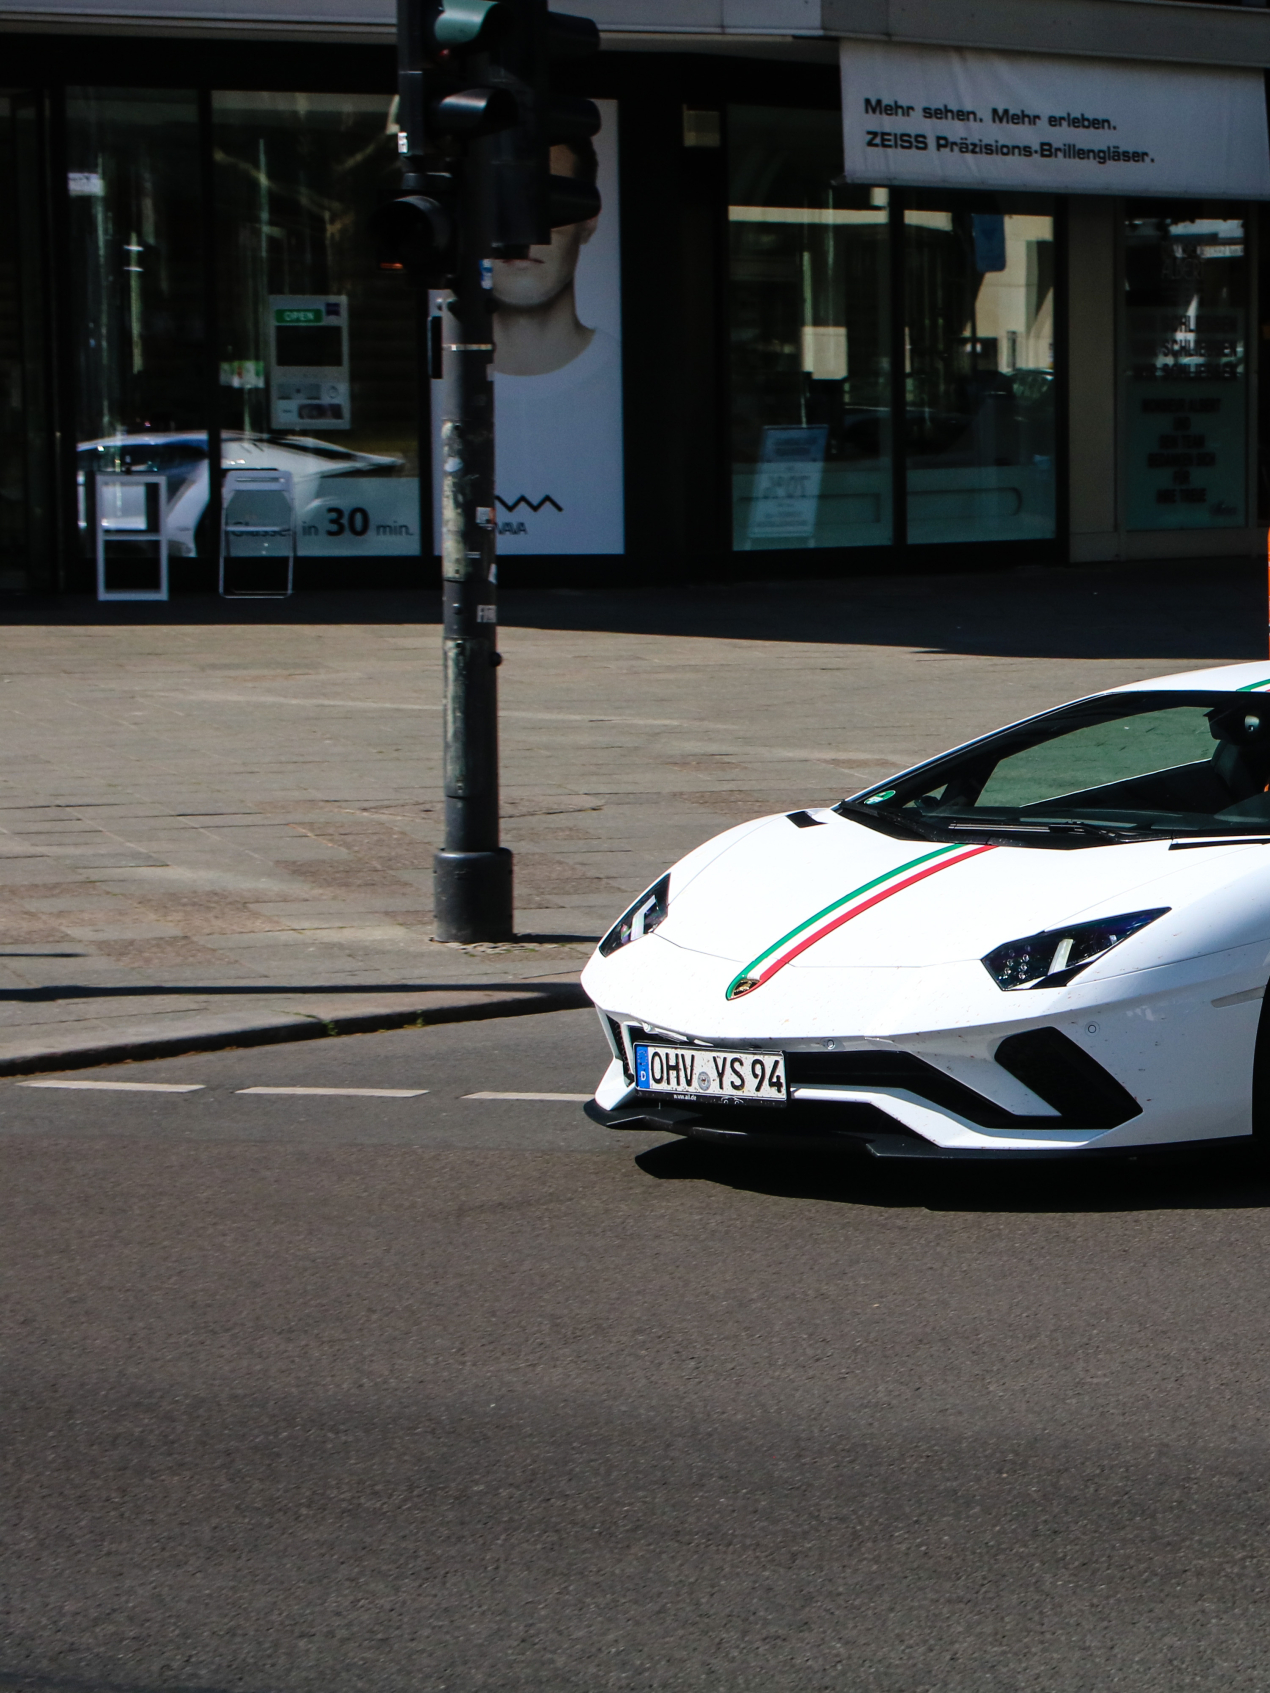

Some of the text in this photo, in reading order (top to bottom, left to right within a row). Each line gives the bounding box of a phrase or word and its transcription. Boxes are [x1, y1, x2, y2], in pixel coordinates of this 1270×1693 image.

[863, 97, 1117, 131] Mehr sehen. Mehr erleben.
[865, 131, 1156, 164] ZEISS Präzisions-Brillengläser.
[283, 310, 315, 321] OPEN
[302, 521, 319, 536] in
[326, 507, 370, 537] 30
[375, 520, 414, 536] min.
[640, 1051, 783, 1093] D OHV YS 94
